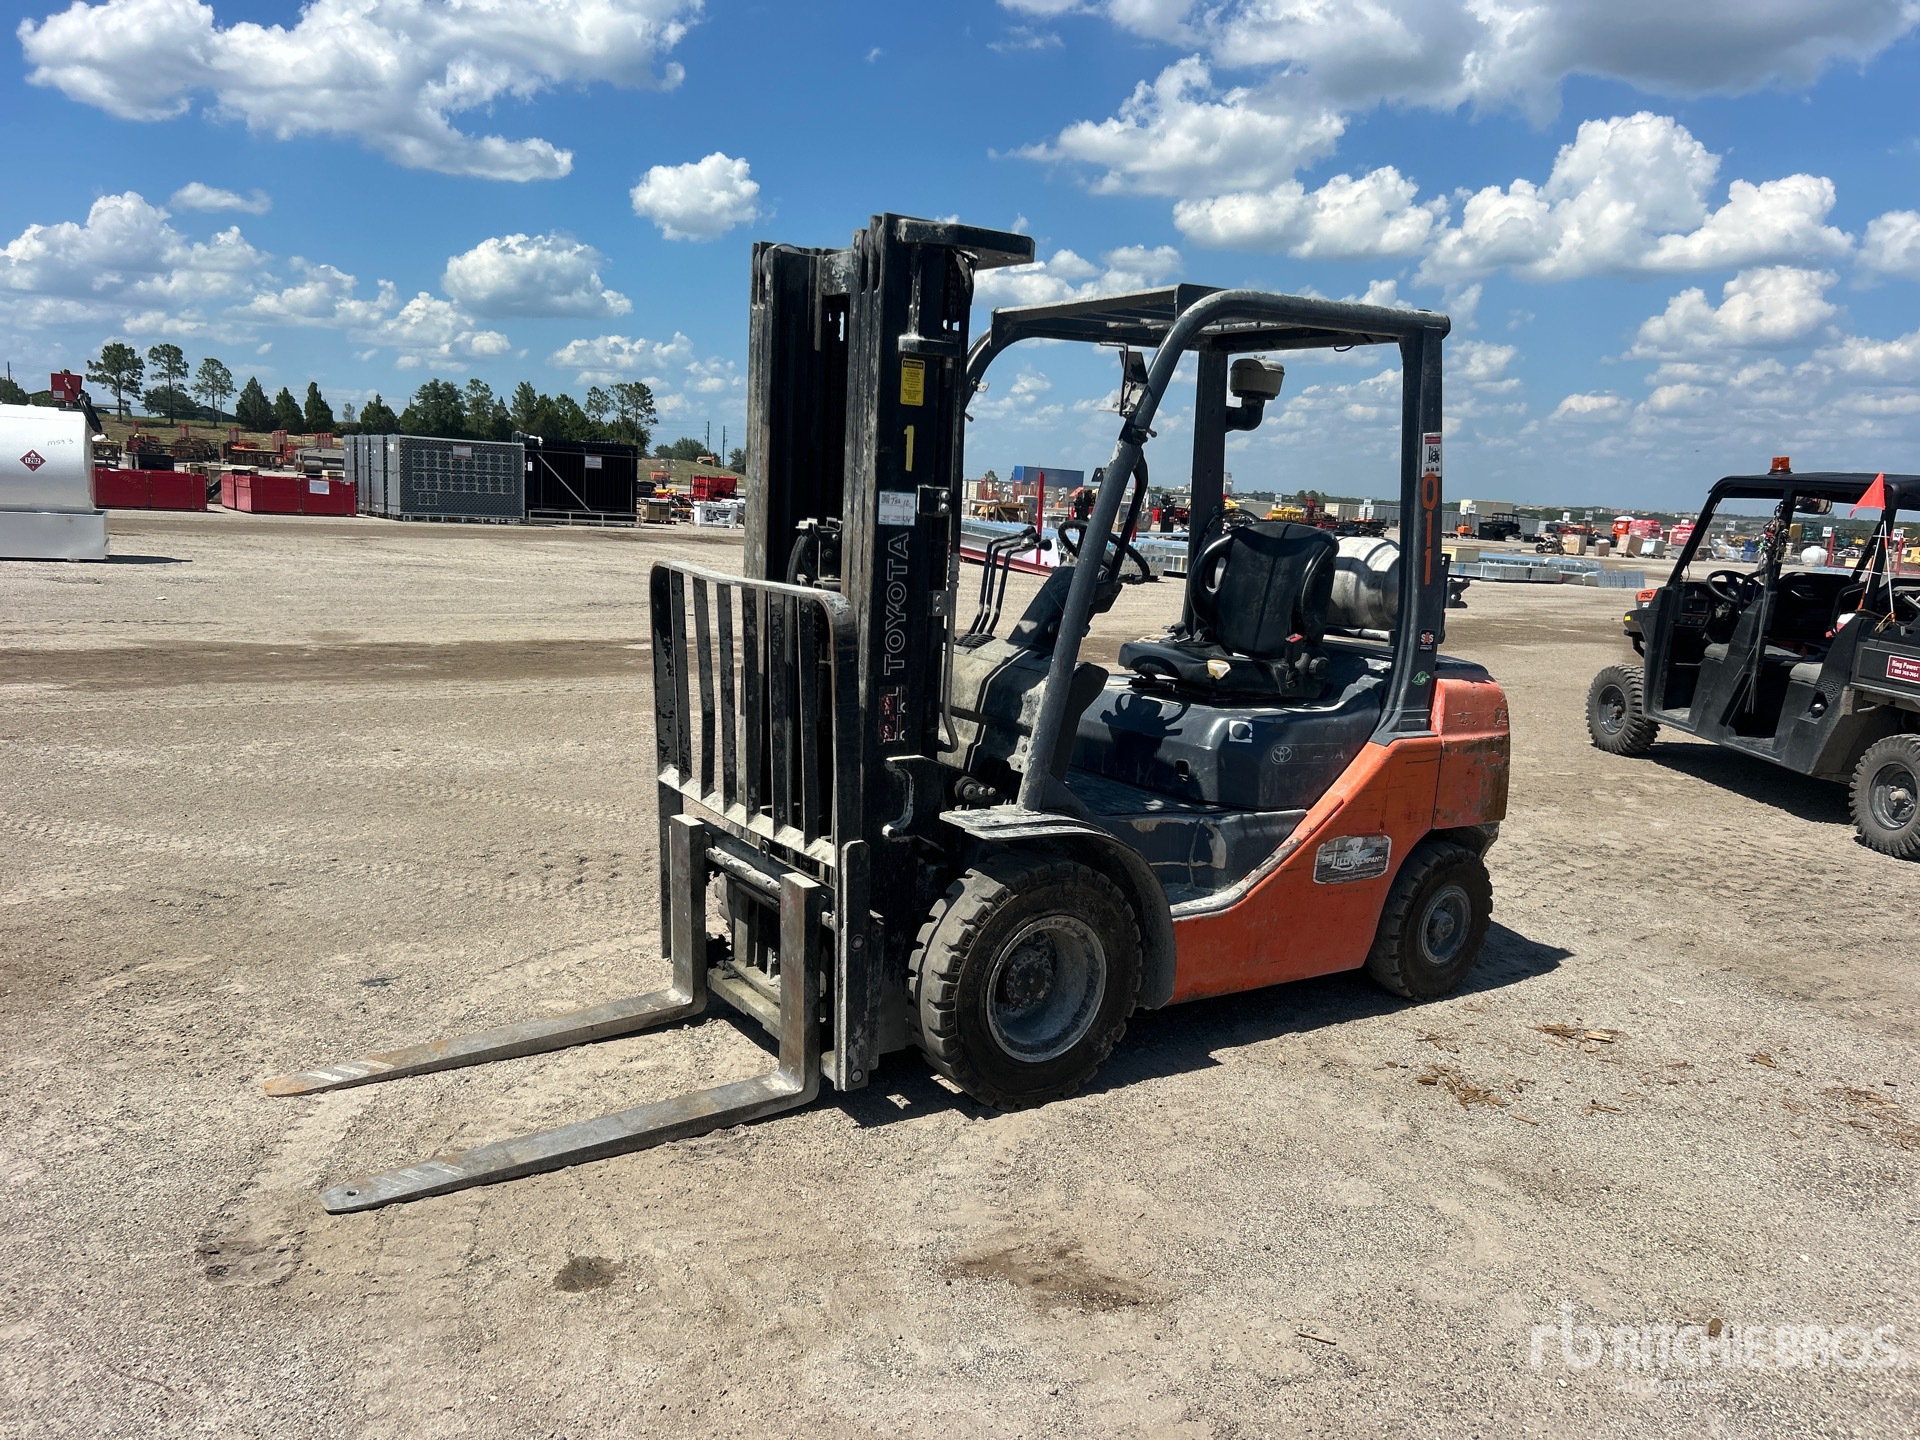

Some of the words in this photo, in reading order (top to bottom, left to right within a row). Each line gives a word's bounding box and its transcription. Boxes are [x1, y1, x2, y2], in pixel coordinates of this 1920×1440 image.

[904, 425, 915, 472] 1
[884, 532, 909, 676] TOYOTA
[1641, 591, 1653, 600] PRO
